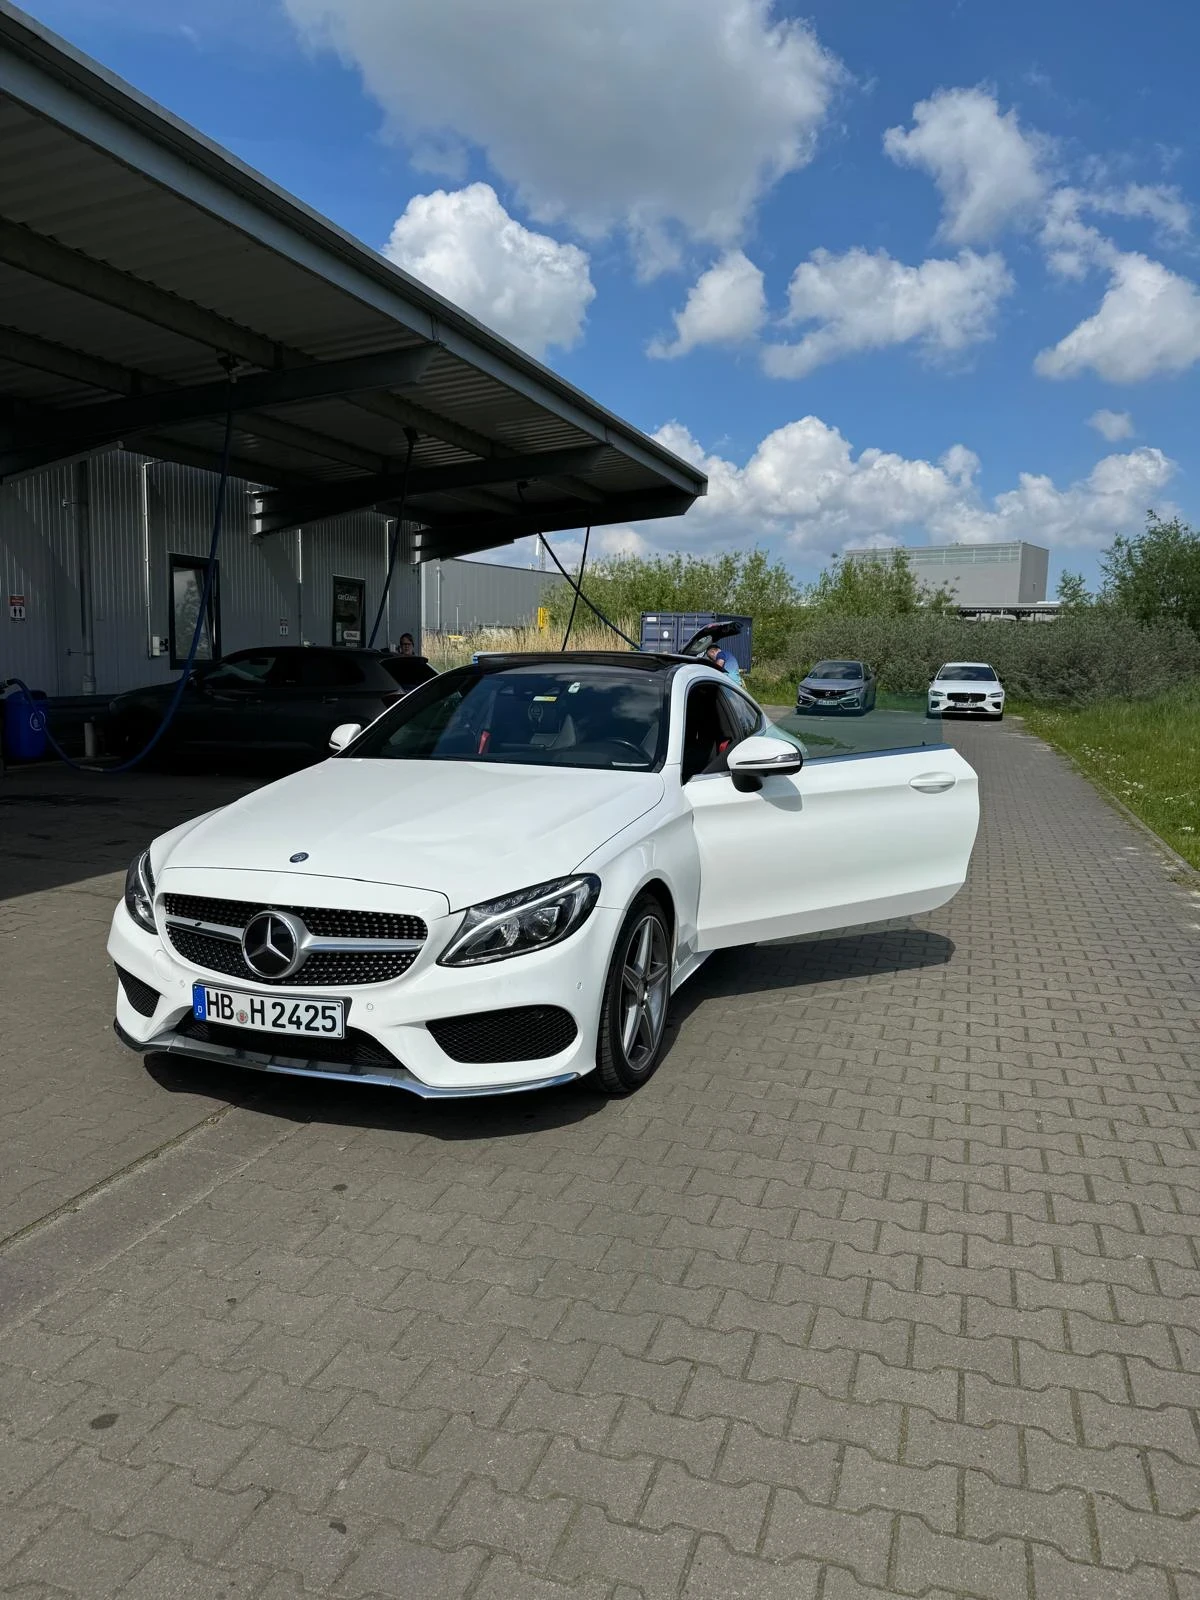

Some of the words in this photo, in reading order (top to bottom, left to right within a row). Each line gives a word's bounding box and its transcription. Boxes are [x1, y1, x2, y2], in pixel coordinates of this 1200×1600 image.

[206, 991, 234, 1020] HB
[250, 998, 265, 1026] H
[271, 1001, 337, 1032] 2425
